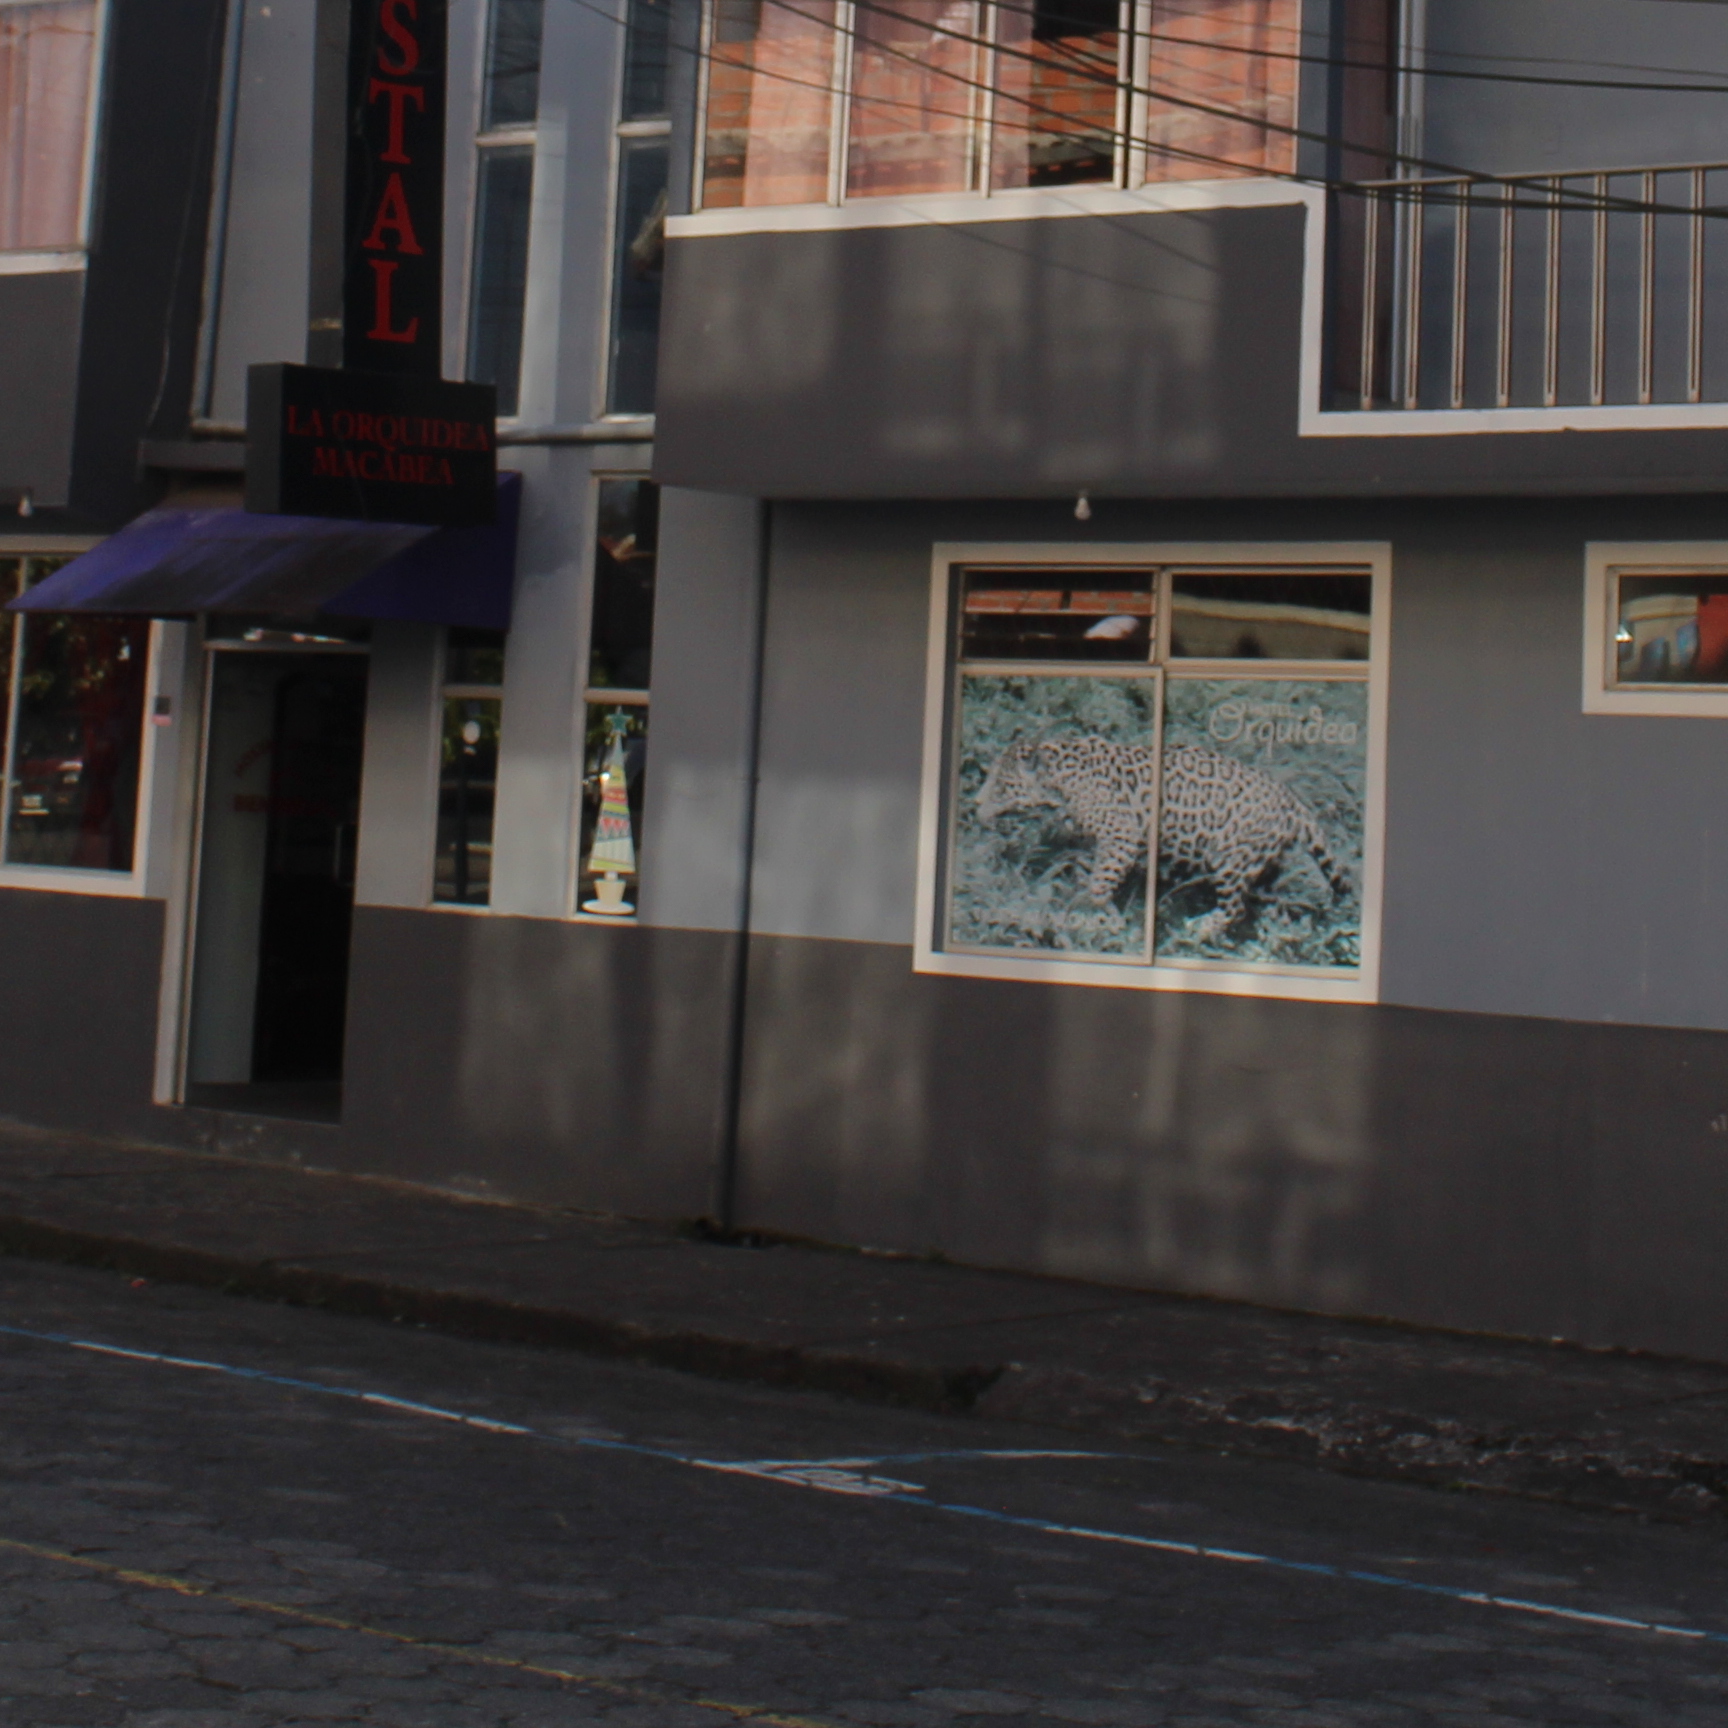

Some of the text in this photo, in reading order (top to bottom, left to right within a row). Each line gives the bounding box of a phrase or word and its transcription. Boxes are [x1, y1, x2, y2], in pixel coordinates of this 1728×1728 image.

[287, 405, 491, 452] LA ORQUIDEA
[1208, 702, 1357, 759] Orquidea
